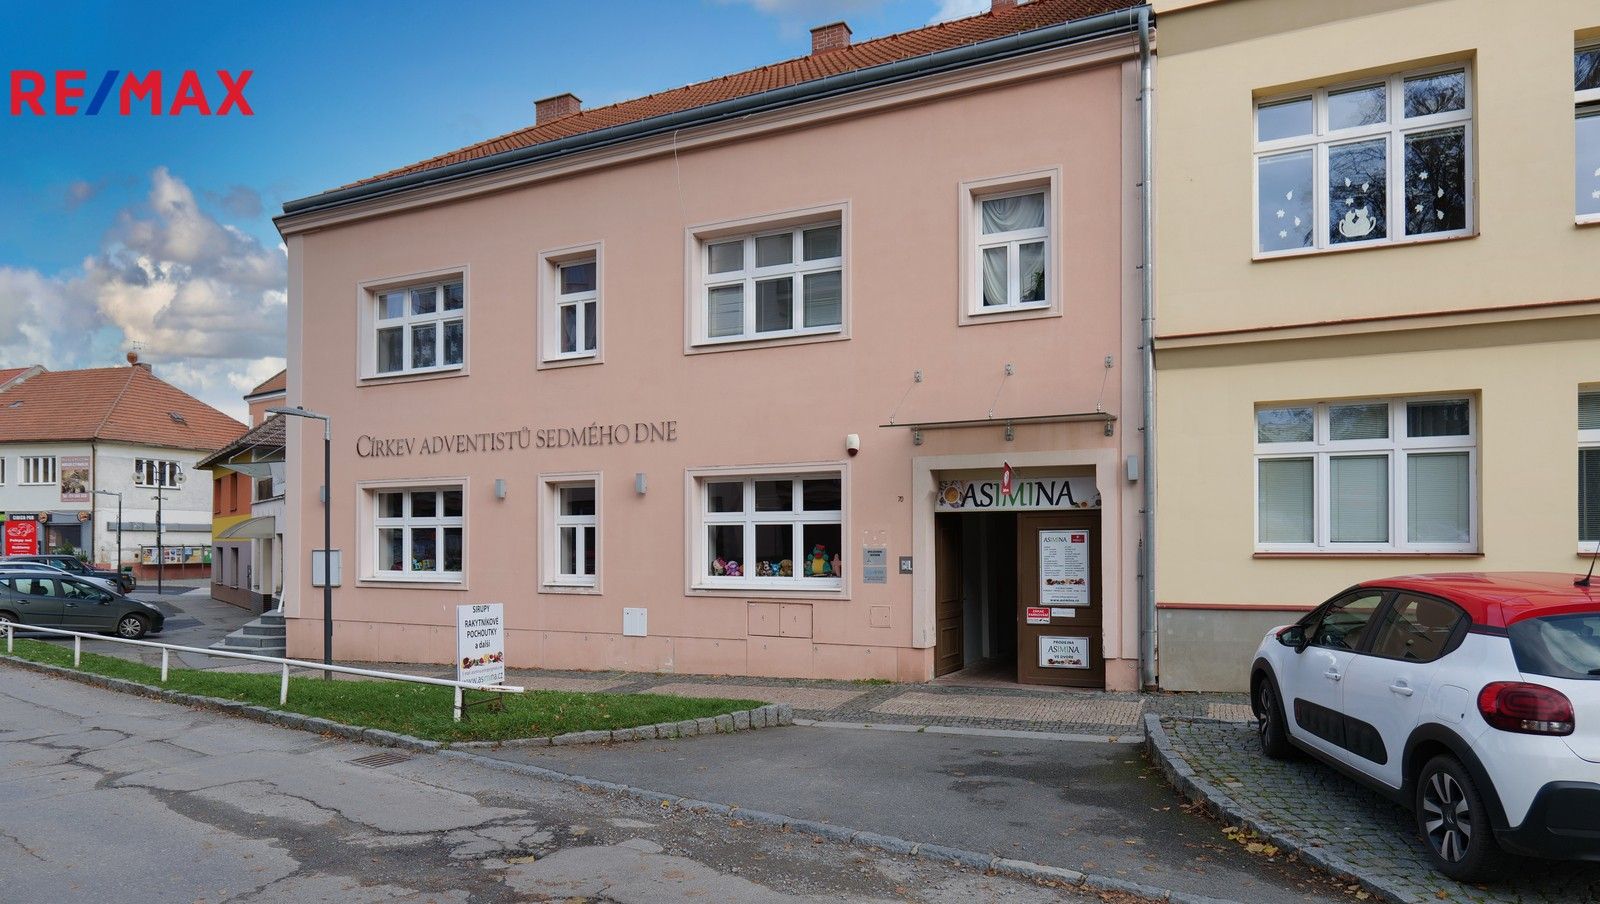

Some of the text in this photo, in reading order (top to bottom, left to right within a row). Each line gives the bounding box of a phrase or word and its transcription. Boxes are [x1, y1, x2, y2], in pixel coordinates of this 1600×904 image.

[356, 420, 678, 458] CÍRKEV ADVENTISTŮ SEDMÉHO DNE
[961, 480, 1077, 507] ASIMINA
[472, 605, 490, 613] SIRUPY
[464, 617, 498, 628] RAKYTNÍKOVÉ
[466, 628, 498, 638] POCHOUTKY
[479, 640, 490, 648] další
